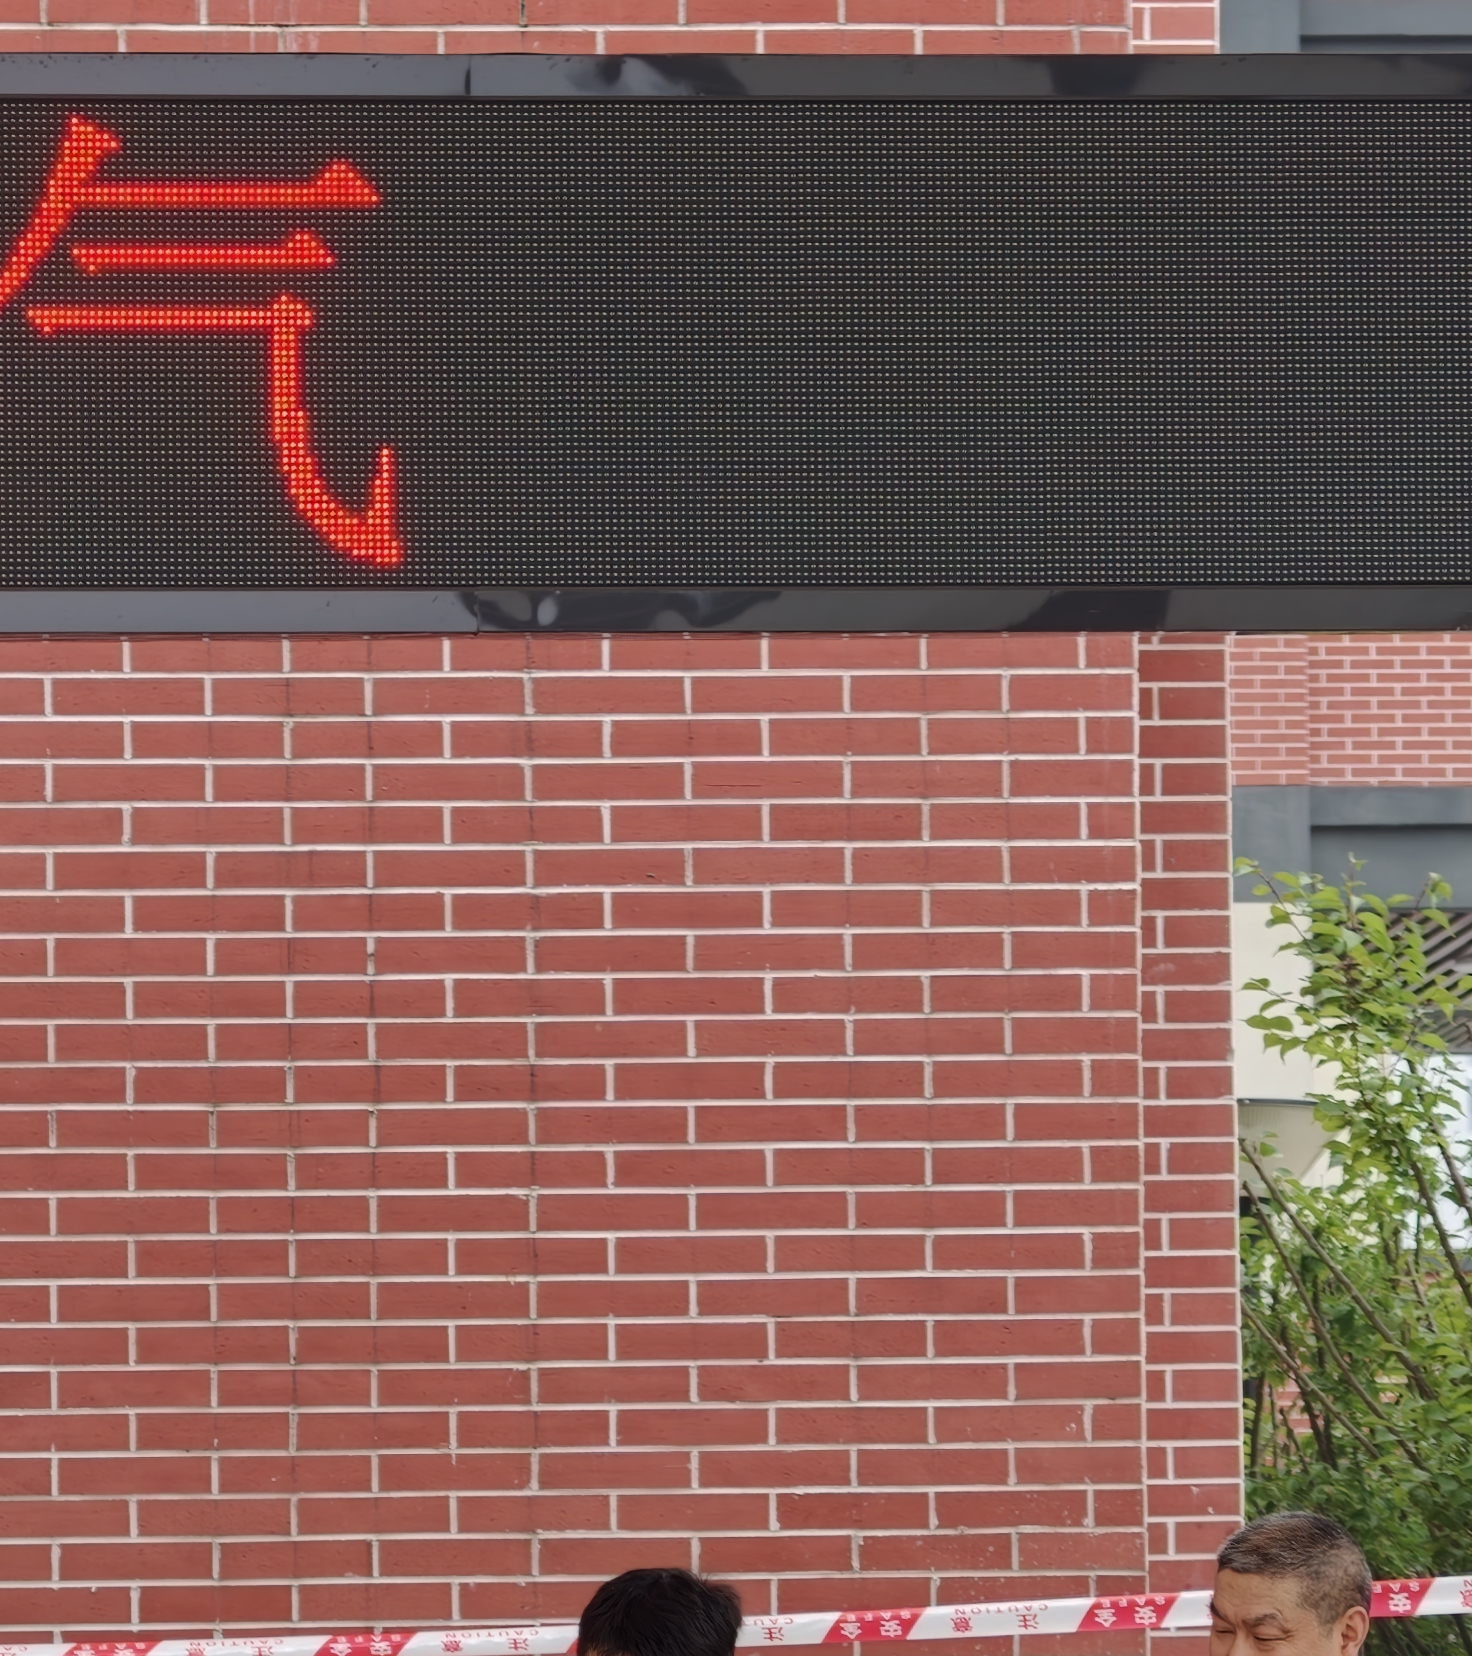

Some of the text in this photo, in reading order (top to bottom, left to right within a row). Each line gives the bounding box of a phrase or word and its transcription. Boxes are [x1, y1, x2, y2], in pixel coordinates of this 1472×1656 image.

[1373, 1581, 1420, 1593] SAF
[1100, 1596, 1165, 1607] SAFE
[848, 1610, 911, 1621] SAFE
[955, 1603, 1048, 1616] CAUTION
[1095, 1606, 1157, 1627] 安全
[950, 1613, 1038, 1633] 注意
[445, 1629, 538, 1640] CAUTION
[840, 1620, 902, 1639] 安全
[190, 1638, 283, 1647] CAUTION
[336, 1634, 400, 1644] SAFE
[441, 1637, 528, 1655] 注意
